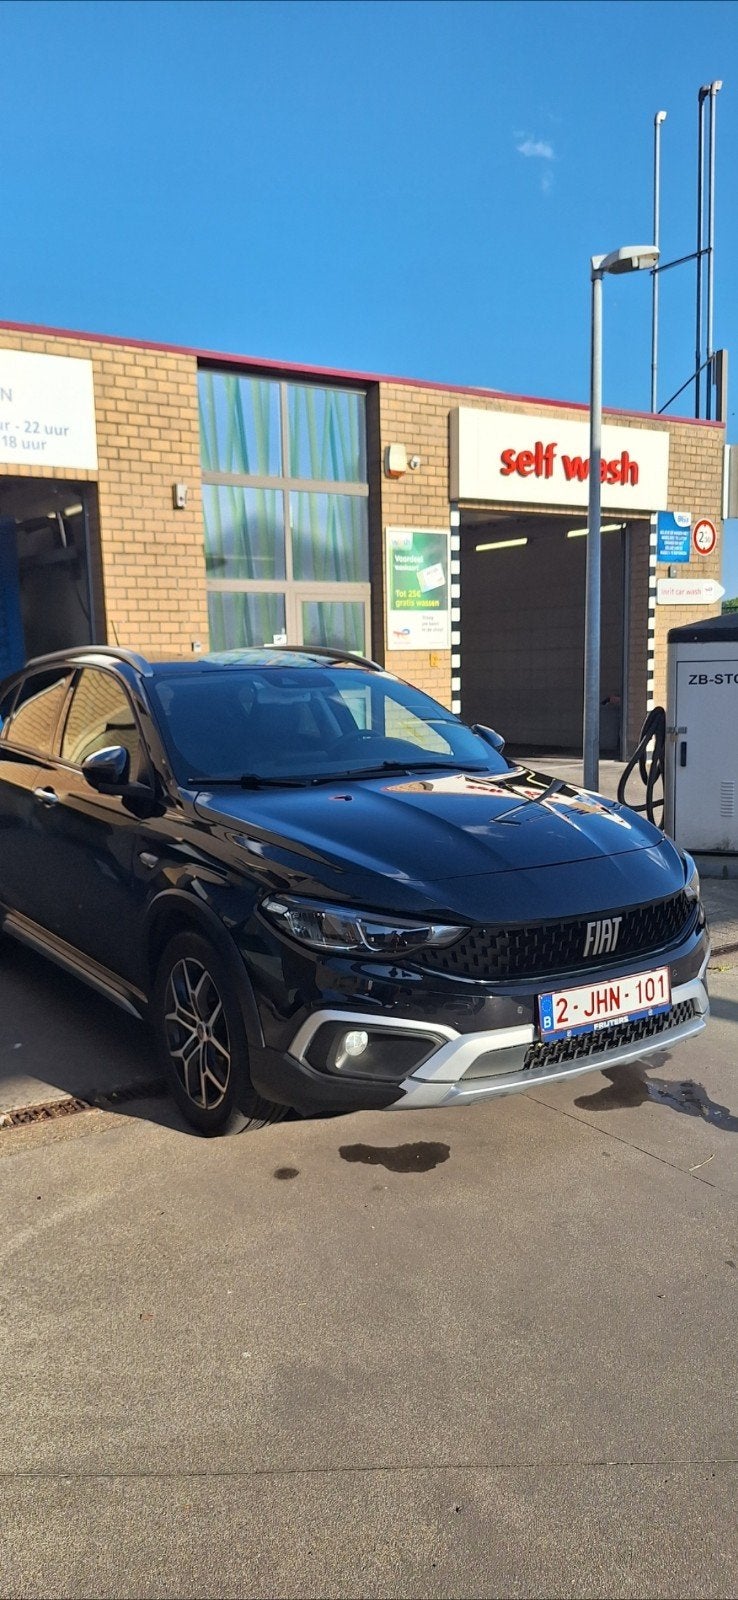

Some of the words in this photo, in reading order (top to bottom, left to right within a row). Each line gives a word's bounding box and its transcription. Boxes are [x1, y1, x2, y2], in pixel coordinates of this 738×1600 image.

[24, 420, 40, 434] 22
[44, 425, 70, 437] uur
[2, 435, 17, 449] 18
[21, 440, 47, 450] uur
[500, 441, 558, 480] self
[395, 590, 406, 598] Tot
[395, 600, 414, 608] gratis
[583, 917, 622, 957] FIAT
[543, 1016, 552, 1028] B
